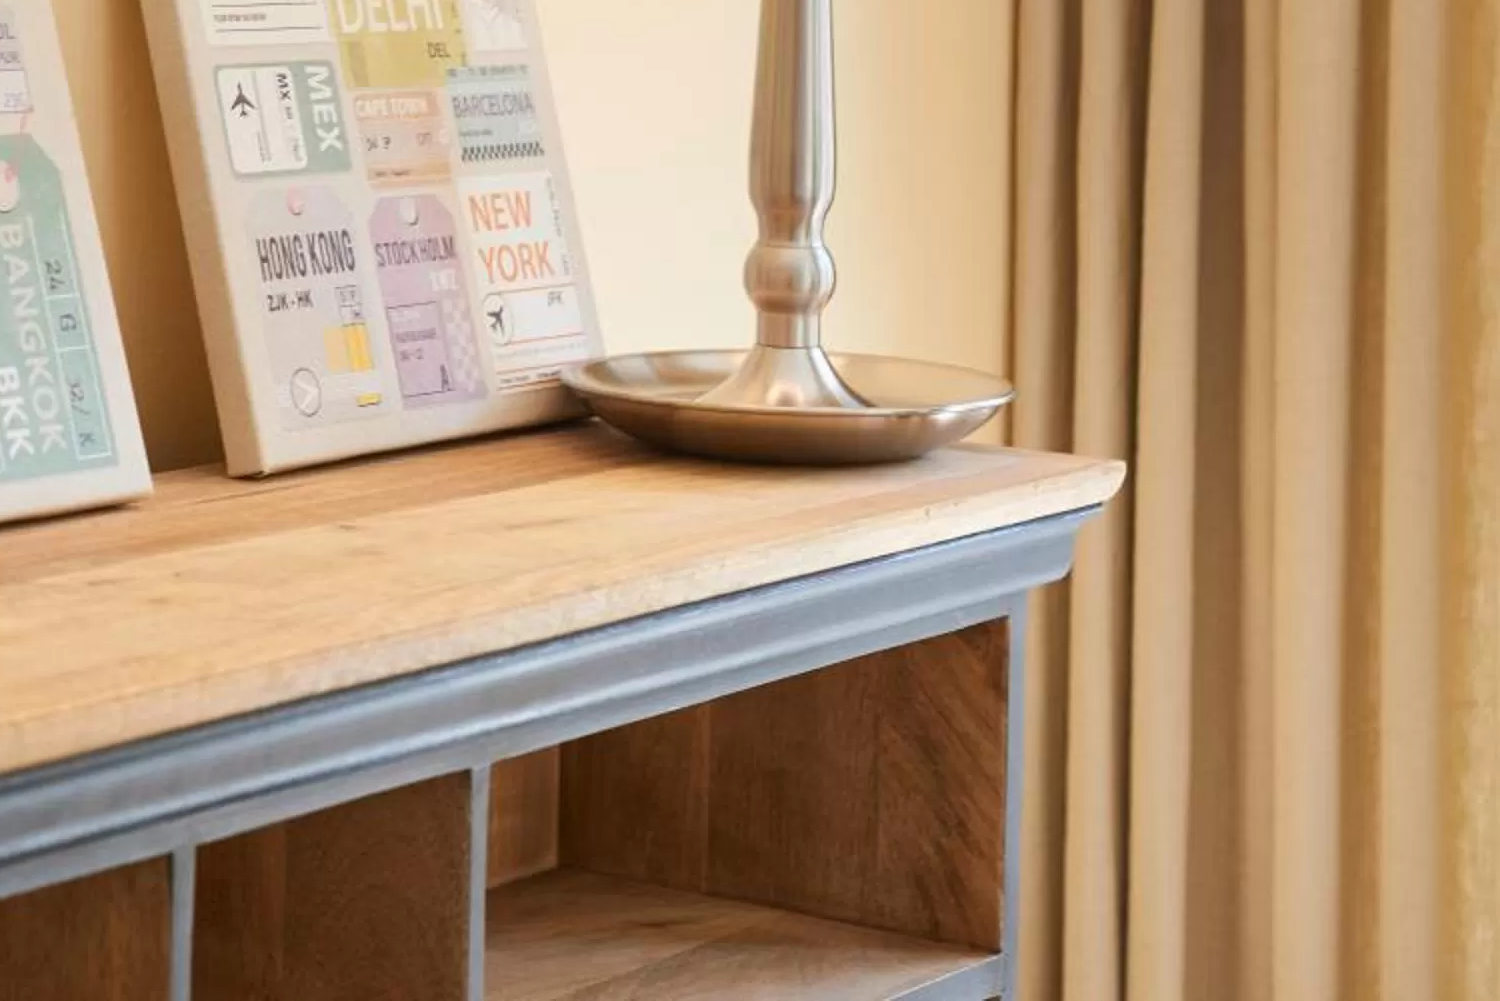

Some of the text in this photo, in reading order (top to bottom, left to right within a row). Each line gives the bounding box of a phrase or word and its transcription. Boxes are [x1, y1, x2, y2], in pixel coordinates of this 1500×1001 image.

[304, 65, 342, 152] MEX
[468, 190, 532, 232] NEW
[256, 228, 356, 283] HONG KONG
[375, 235, 456, 268] STOCKHOLM
[477, 240, 556, 284] YORK
